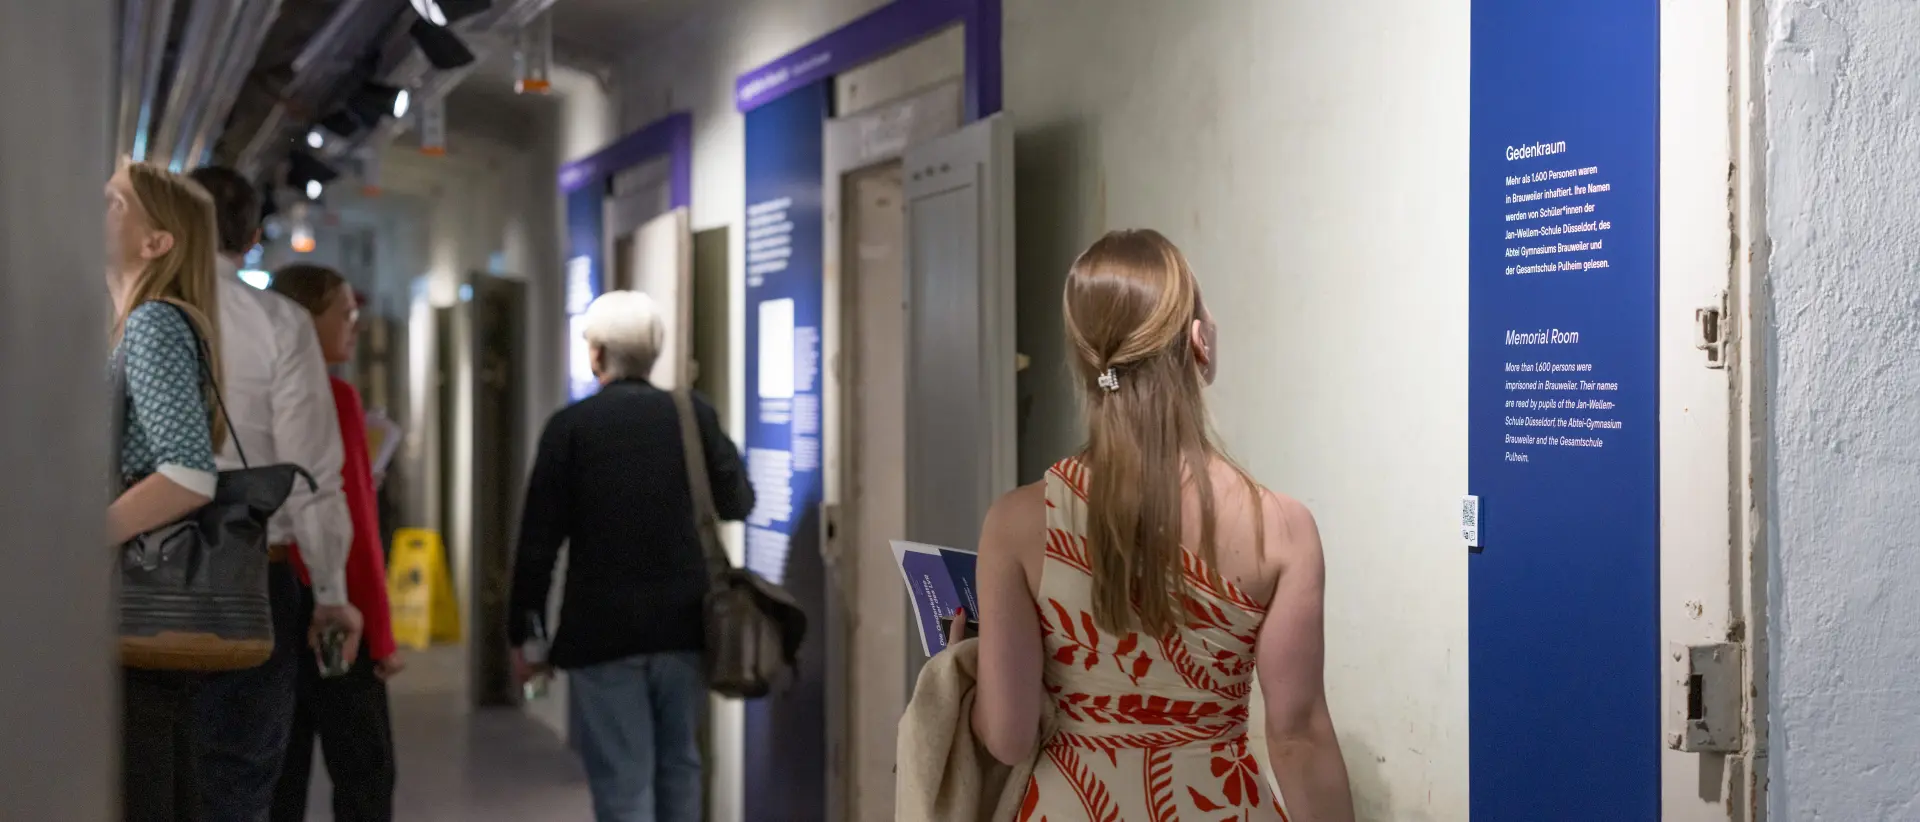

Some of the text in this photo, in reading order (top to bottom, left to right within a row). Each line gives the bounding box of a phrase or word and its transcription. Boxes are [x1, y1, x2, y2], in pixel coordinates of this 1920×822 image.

[1506, 141, 1566, 161] Gedenkraum
[1506, 176, 1521, 186] Mehr
[1522, 174, 1530, 184] als
[1549, 169, 1577, 180] Personen
[1578, 166, 1598, 175] waren
[1506, 183, 1610, 204] in Brauweiler inhaftiert. Ihre Namen
[1506, 211, 1526, 222] werden
[1528, 210, 1538, 219] von
[1584, 203, 1595, 212] der
[1505, 220, 1610, 240] Jan-Wellem-Schule Düsseldorf, des
[1505, 240, 1602, 258] Abtei Gymnasiums Brauweiler und
[1506, 259, 1609, 275] der Gesamtschule Pulheim gelesen.
[1506, 328, 1579, 345] Memorial Room
[1505, 362, 1520, 372] More
[1521, 363, 1534, 372] than
[1552, 363, 1576, 374] persons
[1576, 363, 1592, 371] were
[1505, 381, 1536, 392] imprisoned
[1538, 381, 1543, 390] in
[1545, 381, 1578, 390] Brauweiler.
[1580, 380, 1595, 390] Their
[1516, 399, 1529, 408] read
[1530, 399, 1537, 410] by
[1538, 399, 1556, 410] pupils
[1558, 400, 1564, 409] of
[1565, 400, 1576, 409] the
[1576, 400, 1615, 410] Jan-Wellem-
[1505, 416, 1622, 430] Schule Düsseldorf, the Abtei-Gymnasium
[1505, 434, 1603, 448] Brauweiler and the Gesamtschule
[1505, 452, 1529, 462] Pulheim.
